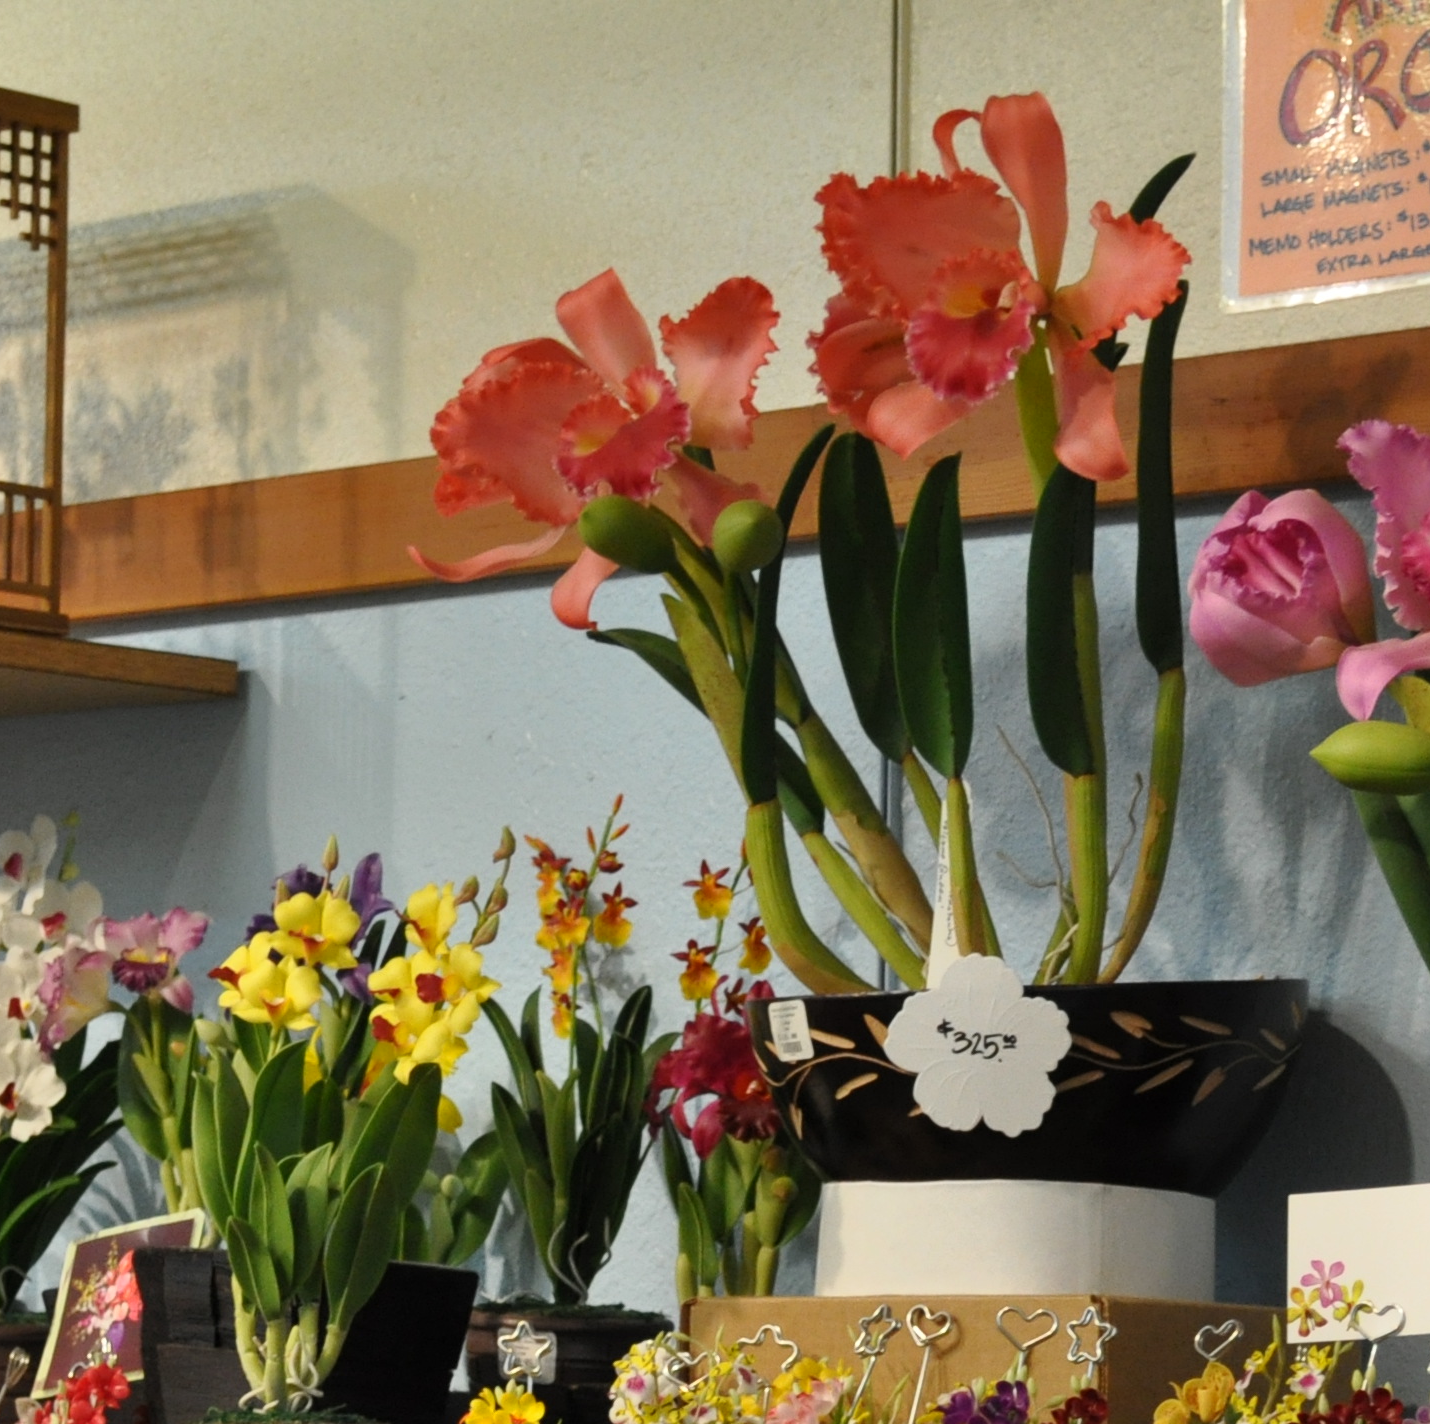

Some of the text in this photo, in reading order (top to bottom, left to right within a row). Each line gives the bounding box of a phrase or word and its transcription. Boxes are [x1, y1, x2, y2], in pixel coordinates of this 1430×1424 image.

[1261, 167, 1316, 188] SMALL
[1261, 193, 1316, 219] LARGE
[1323, 180, 1412, 211] MAGNETS:
[1248, 233, 1302, 258] MEMO
[1307, 221, 1393, 251] HOLDERS:
[1315, 253, 1373, 276] EXTRA
